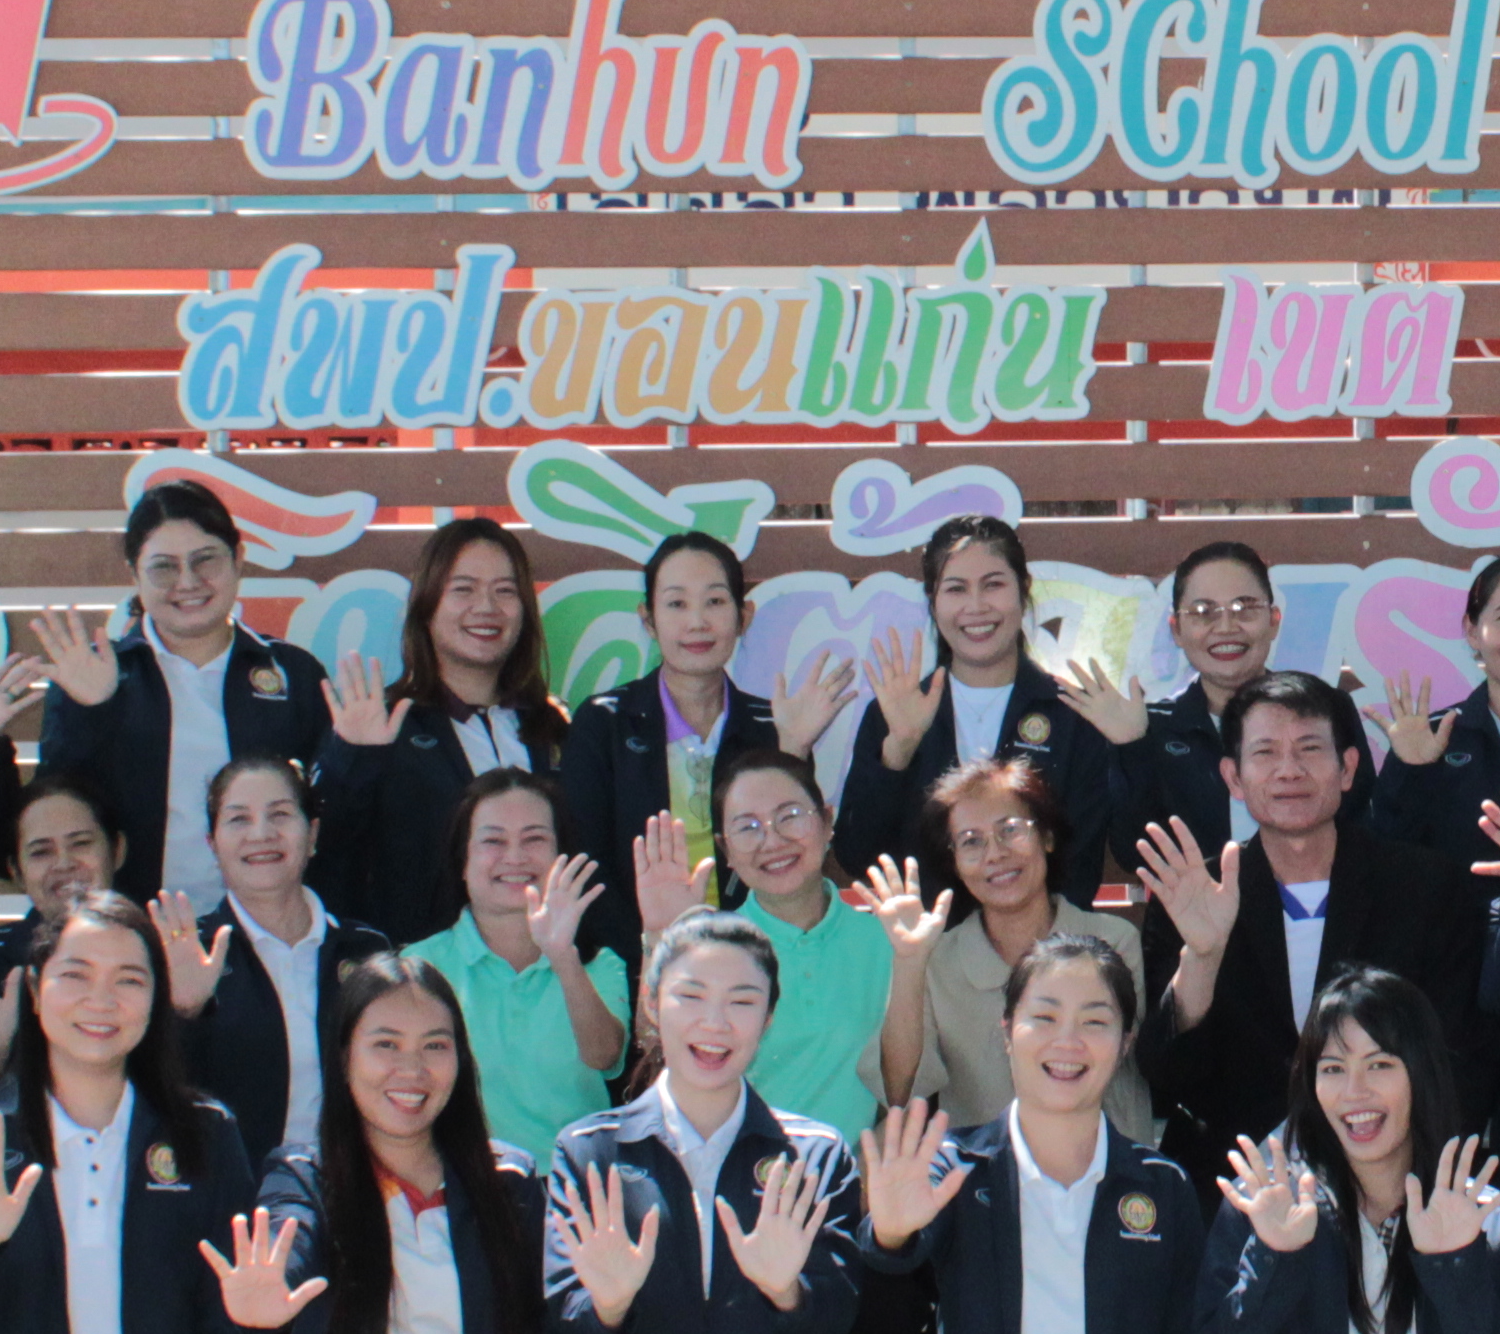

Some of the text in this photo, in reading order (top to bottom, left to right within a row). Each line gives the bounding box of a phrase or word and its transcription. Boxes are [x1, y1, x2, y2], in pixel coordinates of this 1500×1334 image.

[184, 222, 1098, 429] สพป.ขอนแก่น
[1210, 272, 1457, 417] เขต
